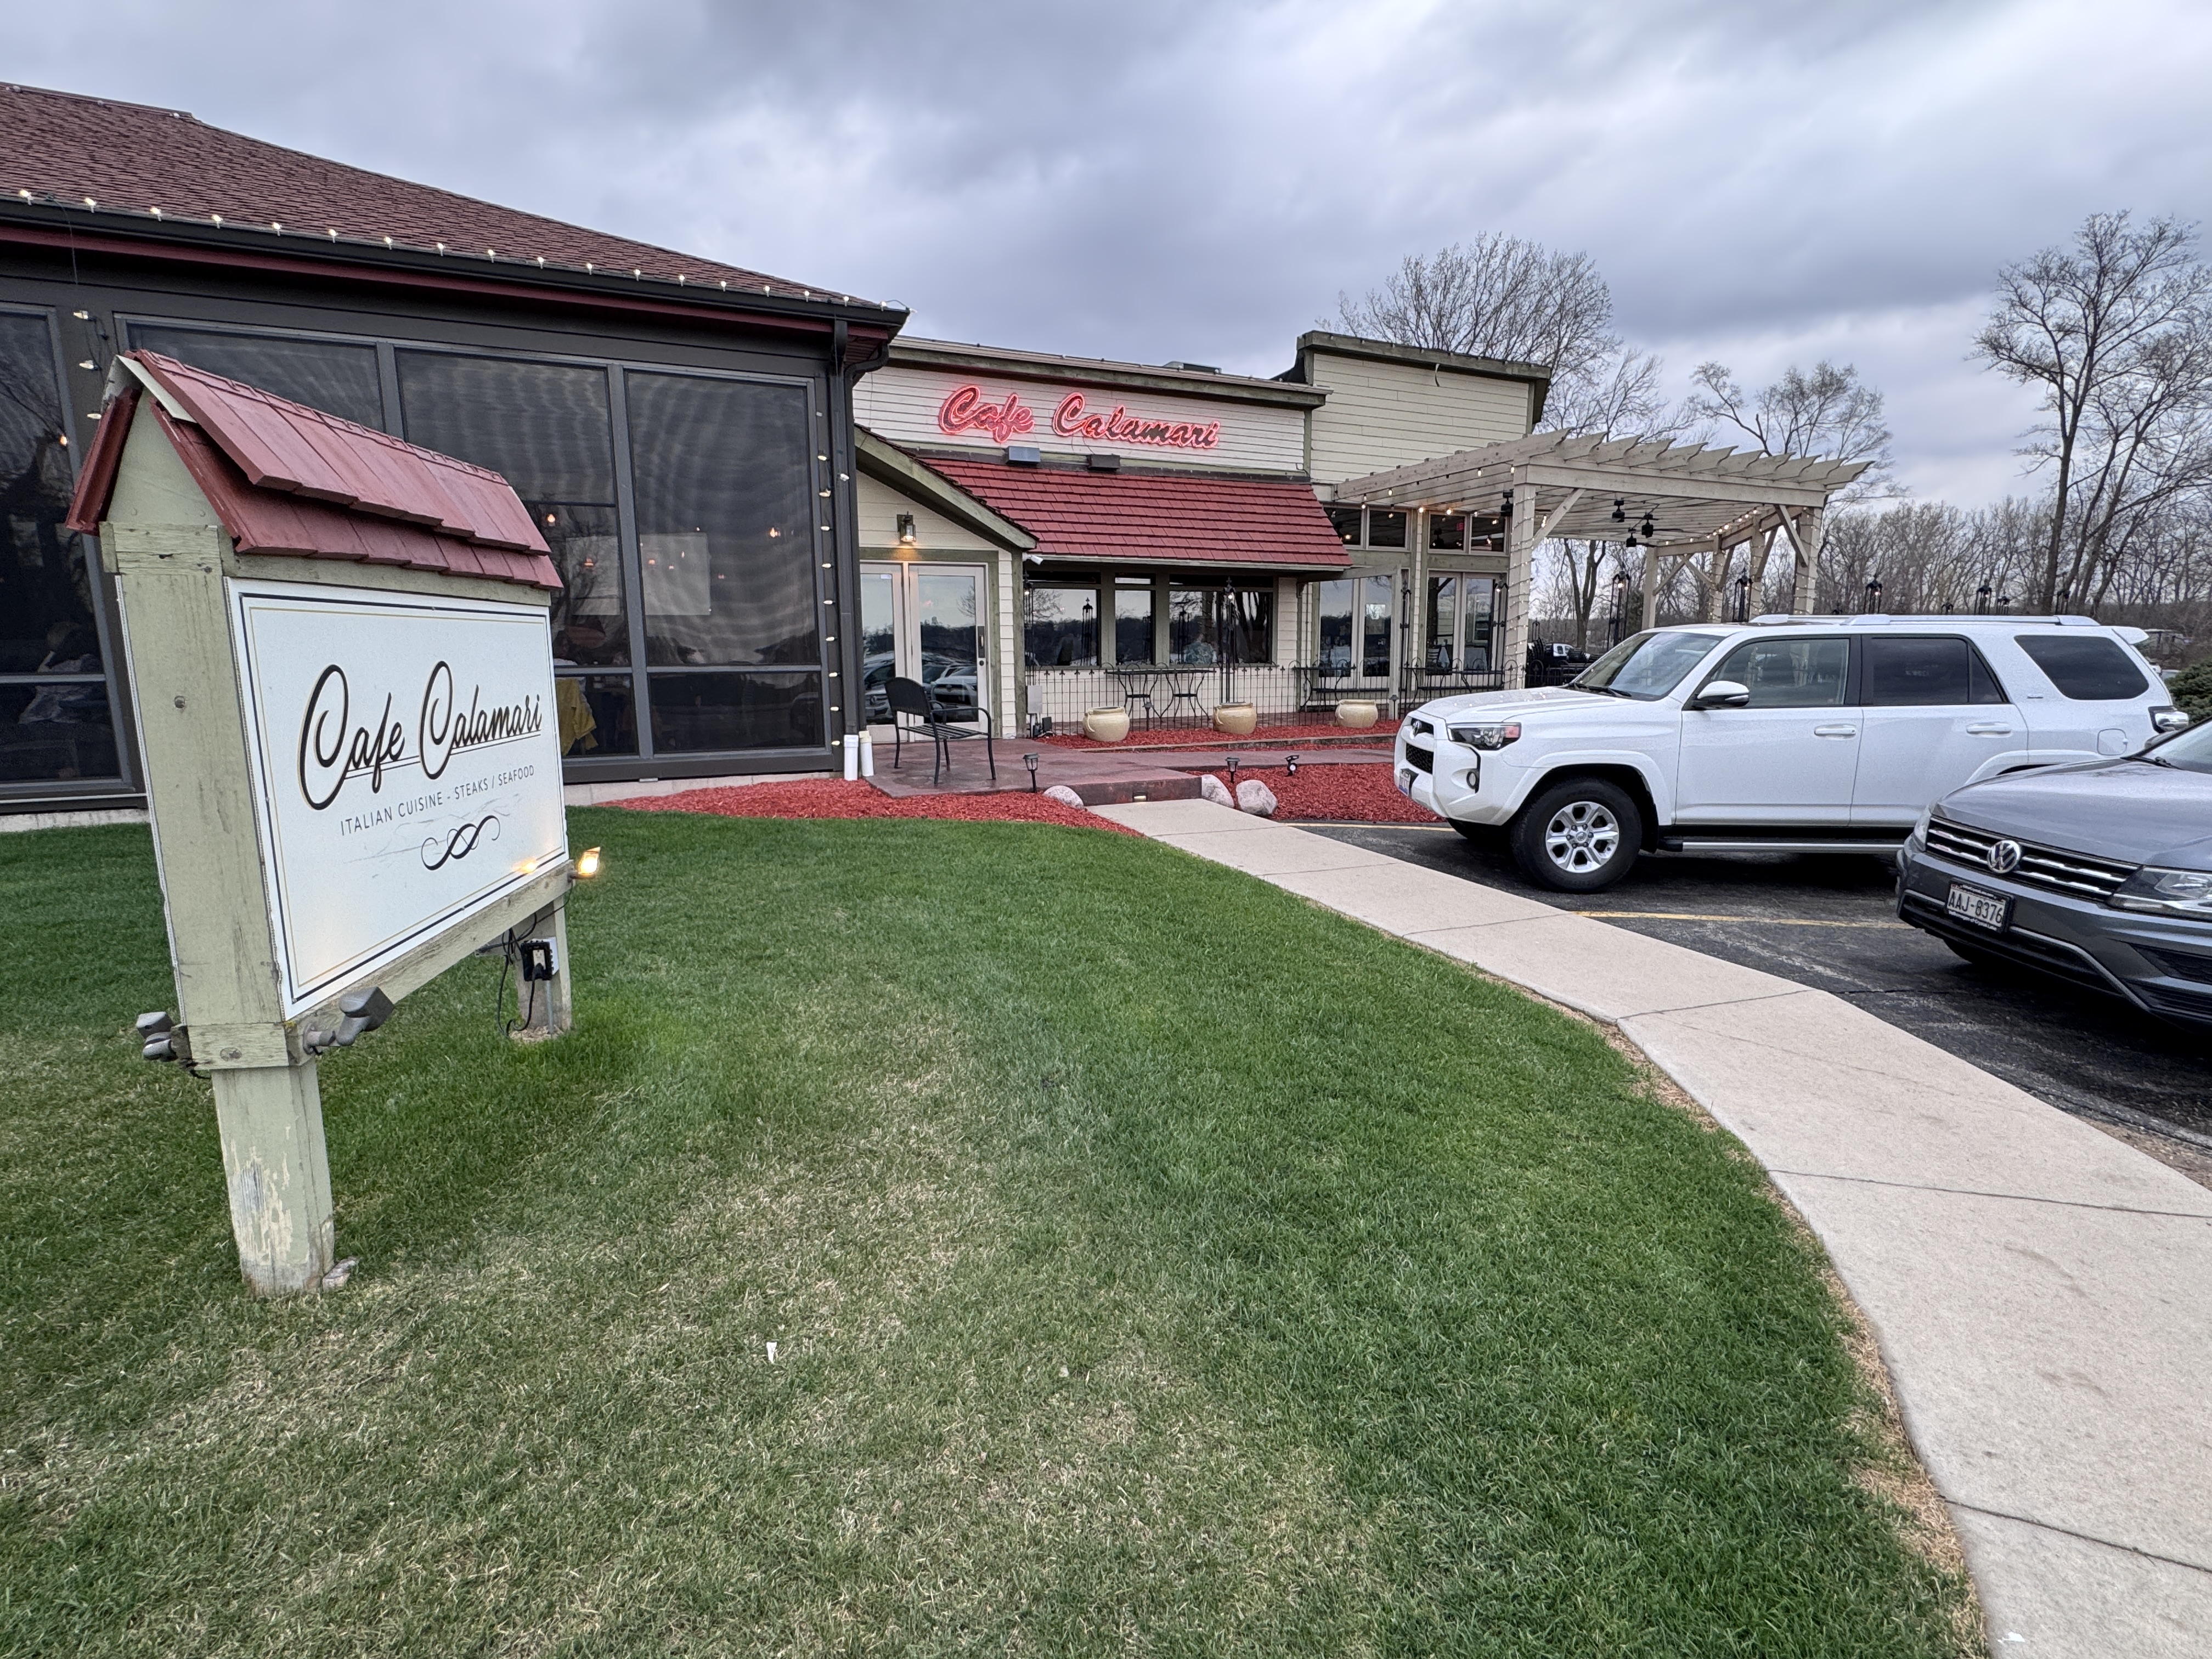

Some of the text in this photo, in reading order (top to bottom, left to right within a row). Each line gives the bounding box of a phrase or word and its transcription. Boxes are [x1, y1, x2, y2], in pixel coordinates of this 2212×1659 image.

[939, 385, 1221, 448] Cafe Calamari
[297, 661, 542, 811] Cafe Calamari
[340, 806, 393, 836] ITALIAN
[398, 792, 443, 817] CUISINE
[454, 778, 488, 800] STEAKS
[498, 765, 534, 786] SEAFOOD
[1948, 891, 2003, 924] AAJ-8376
